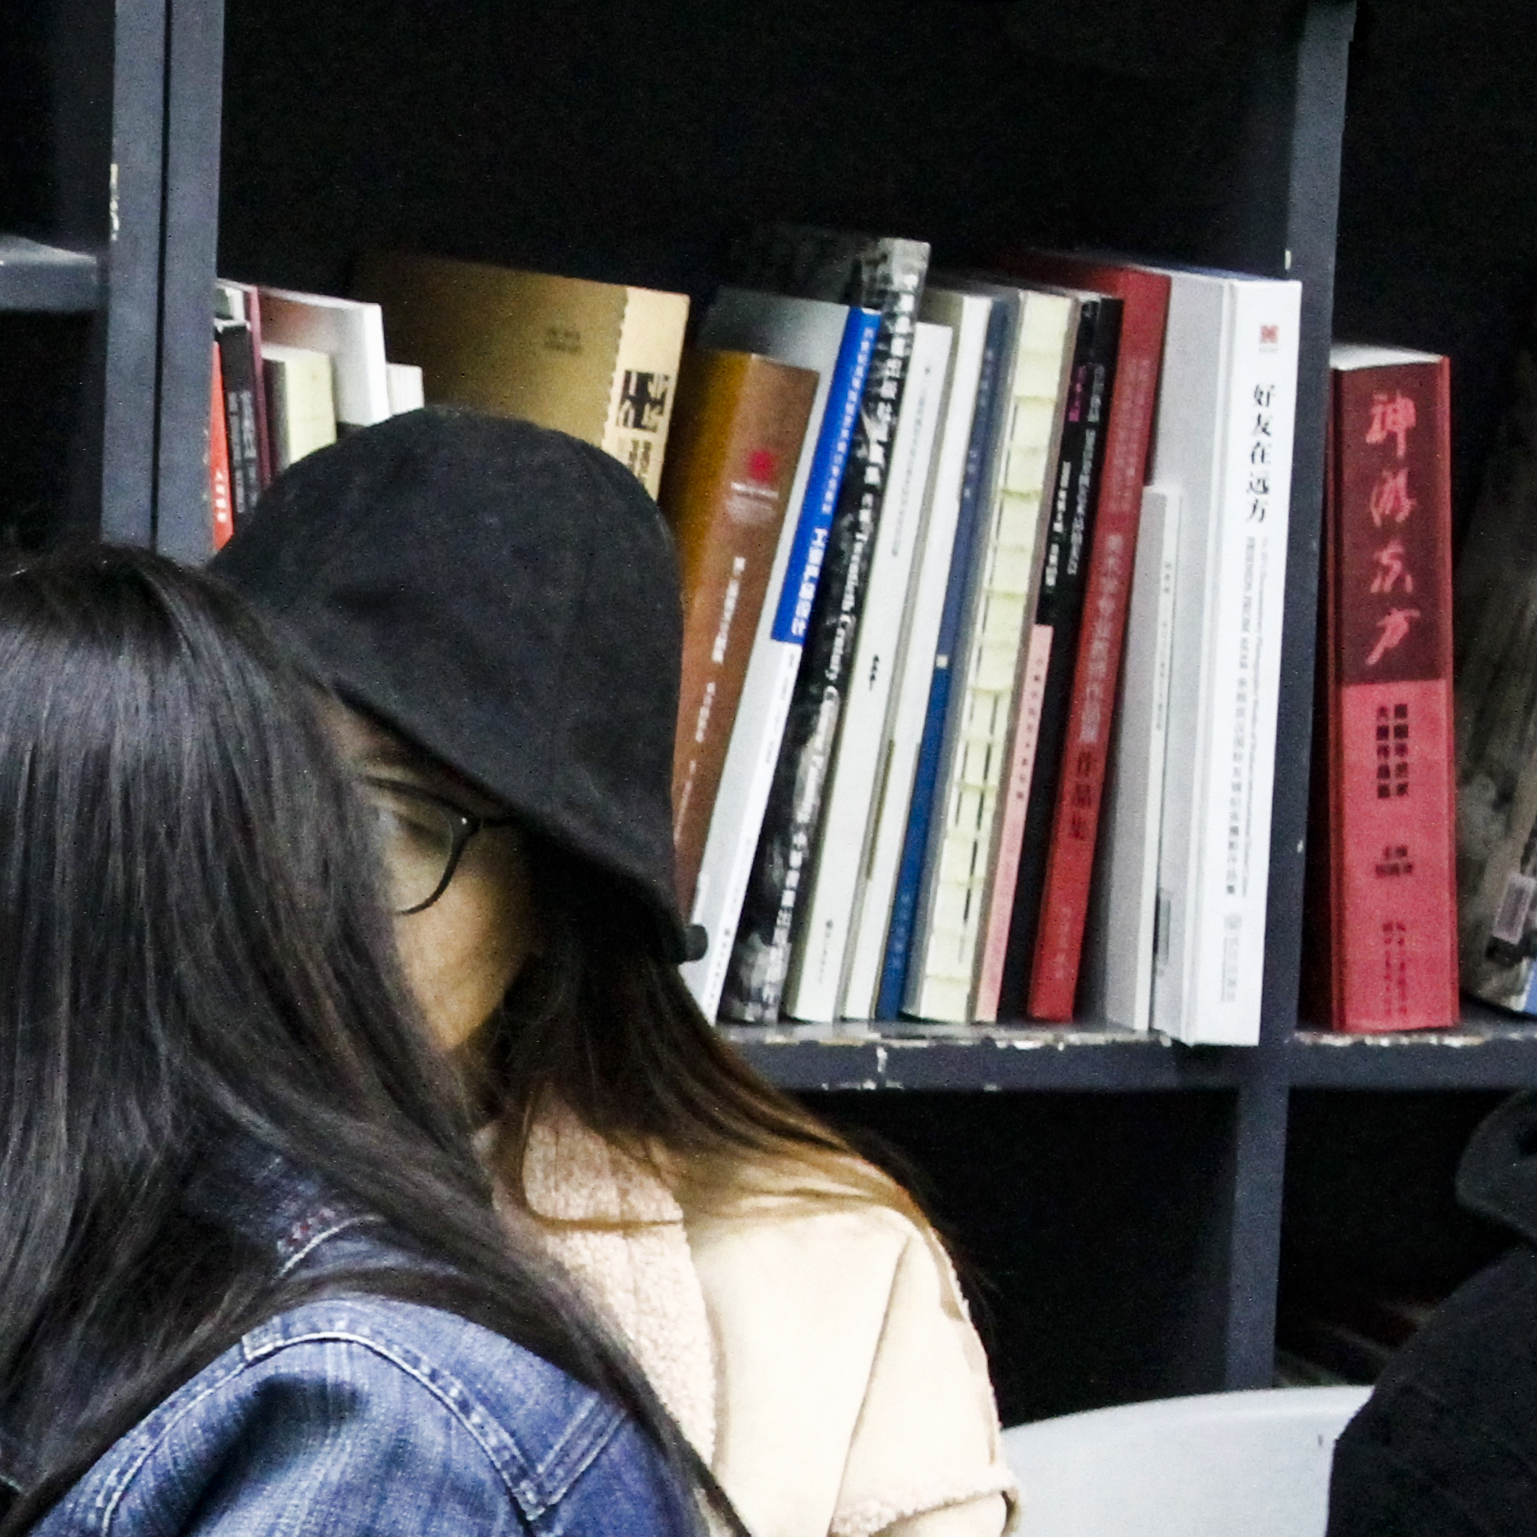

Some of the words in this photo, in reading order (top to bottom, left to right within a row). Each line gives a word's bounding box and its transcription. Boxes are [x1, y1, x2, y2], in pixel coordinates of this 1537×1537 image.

[1247, 382, 1275, 524] 好友在远方
